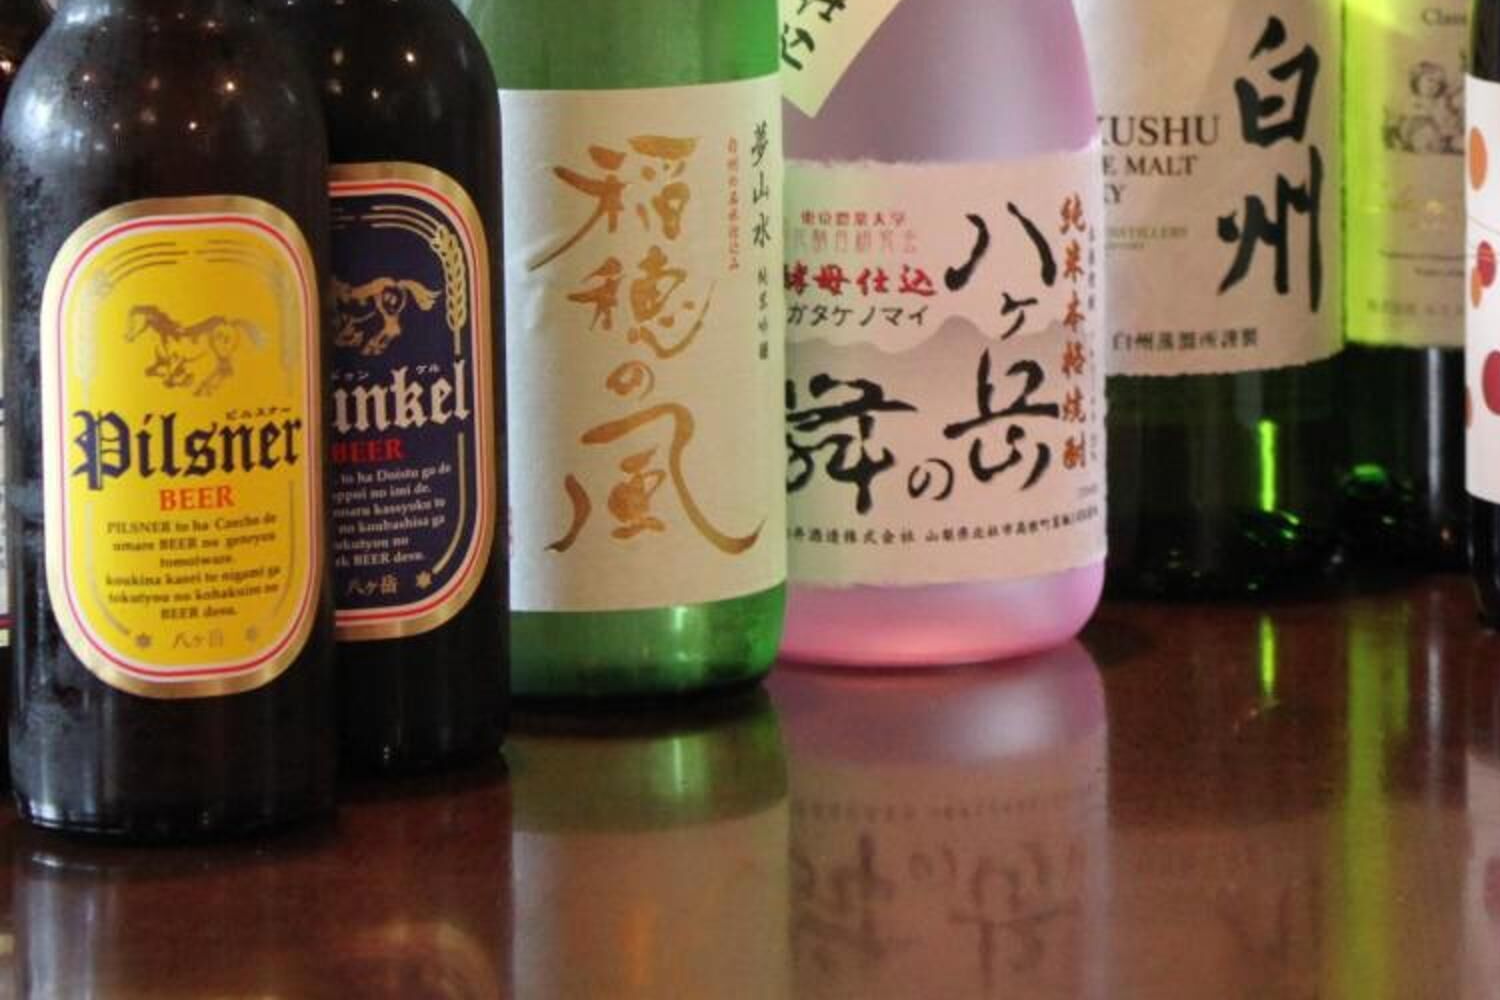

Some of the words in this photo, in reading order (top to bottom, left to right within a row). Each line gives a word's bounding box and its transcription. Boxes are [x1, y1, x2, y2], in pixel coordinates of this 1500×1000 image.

[1125, 154, 1199, 177] MALT
[1215, 15, 1327, 315] 白州
[1059, 193, 1088, 471] 純米本格焼酎
[72, 410, 303, 491] Pilsner
[159, 485, 235, 511] BEER
